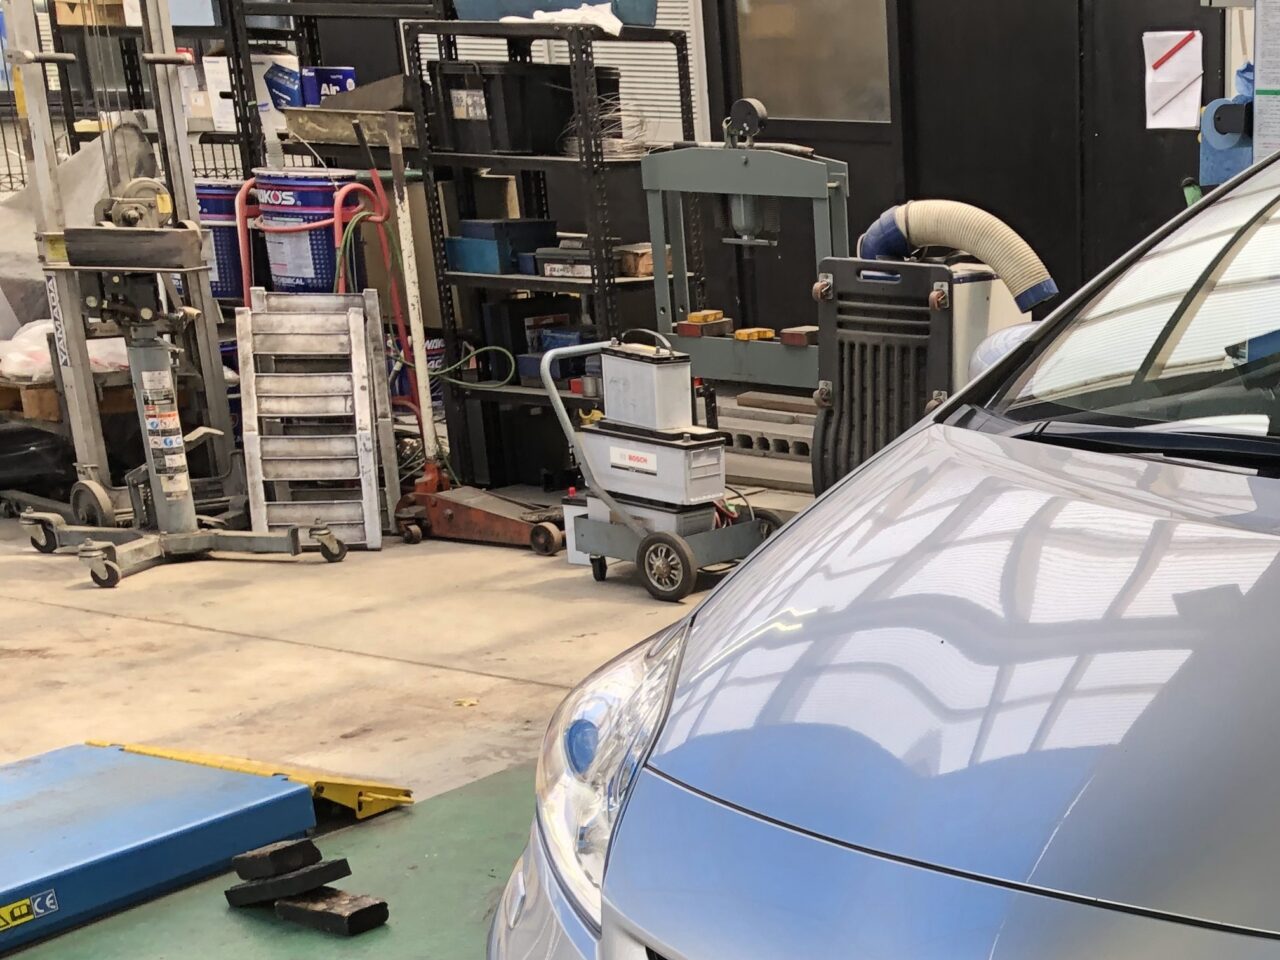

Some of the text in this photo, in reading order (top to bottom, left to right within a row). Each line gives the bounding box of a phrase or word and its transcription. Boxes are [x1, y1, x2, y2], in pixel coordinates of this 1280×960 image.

[320, 83, 340, 95] Air
[47, 276, 69, 366] YAMADA
[34, 893, 56, 913] CE
